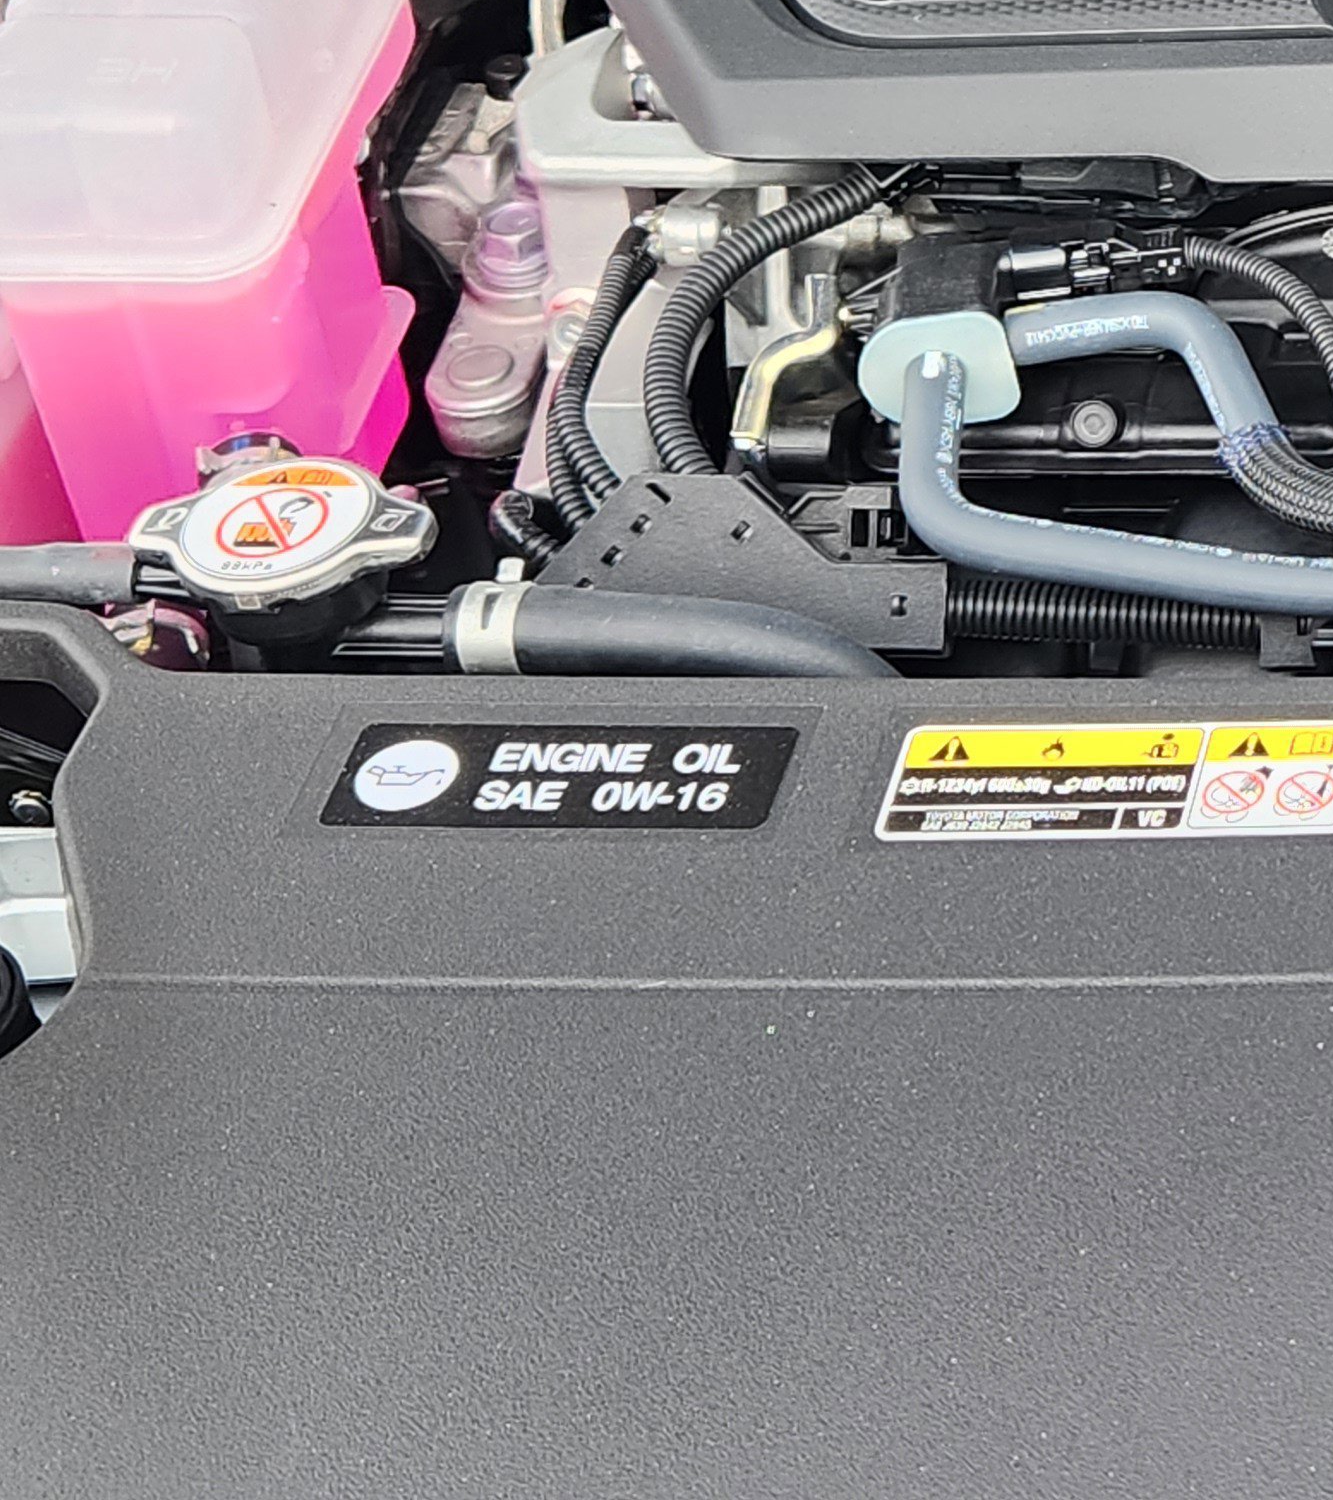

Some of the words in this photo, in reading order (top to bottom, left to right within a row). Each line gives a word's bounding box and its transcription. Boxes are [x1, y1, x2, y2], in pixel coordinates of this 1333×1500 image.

[488, 742, 653, 774] ENGINE
[672, 742, 743, 775] OIL
[473, 780, 569, 811] SAE
[591, 780, 730, 812] 0W-16
[1137, 809, 1166, 827] VC
